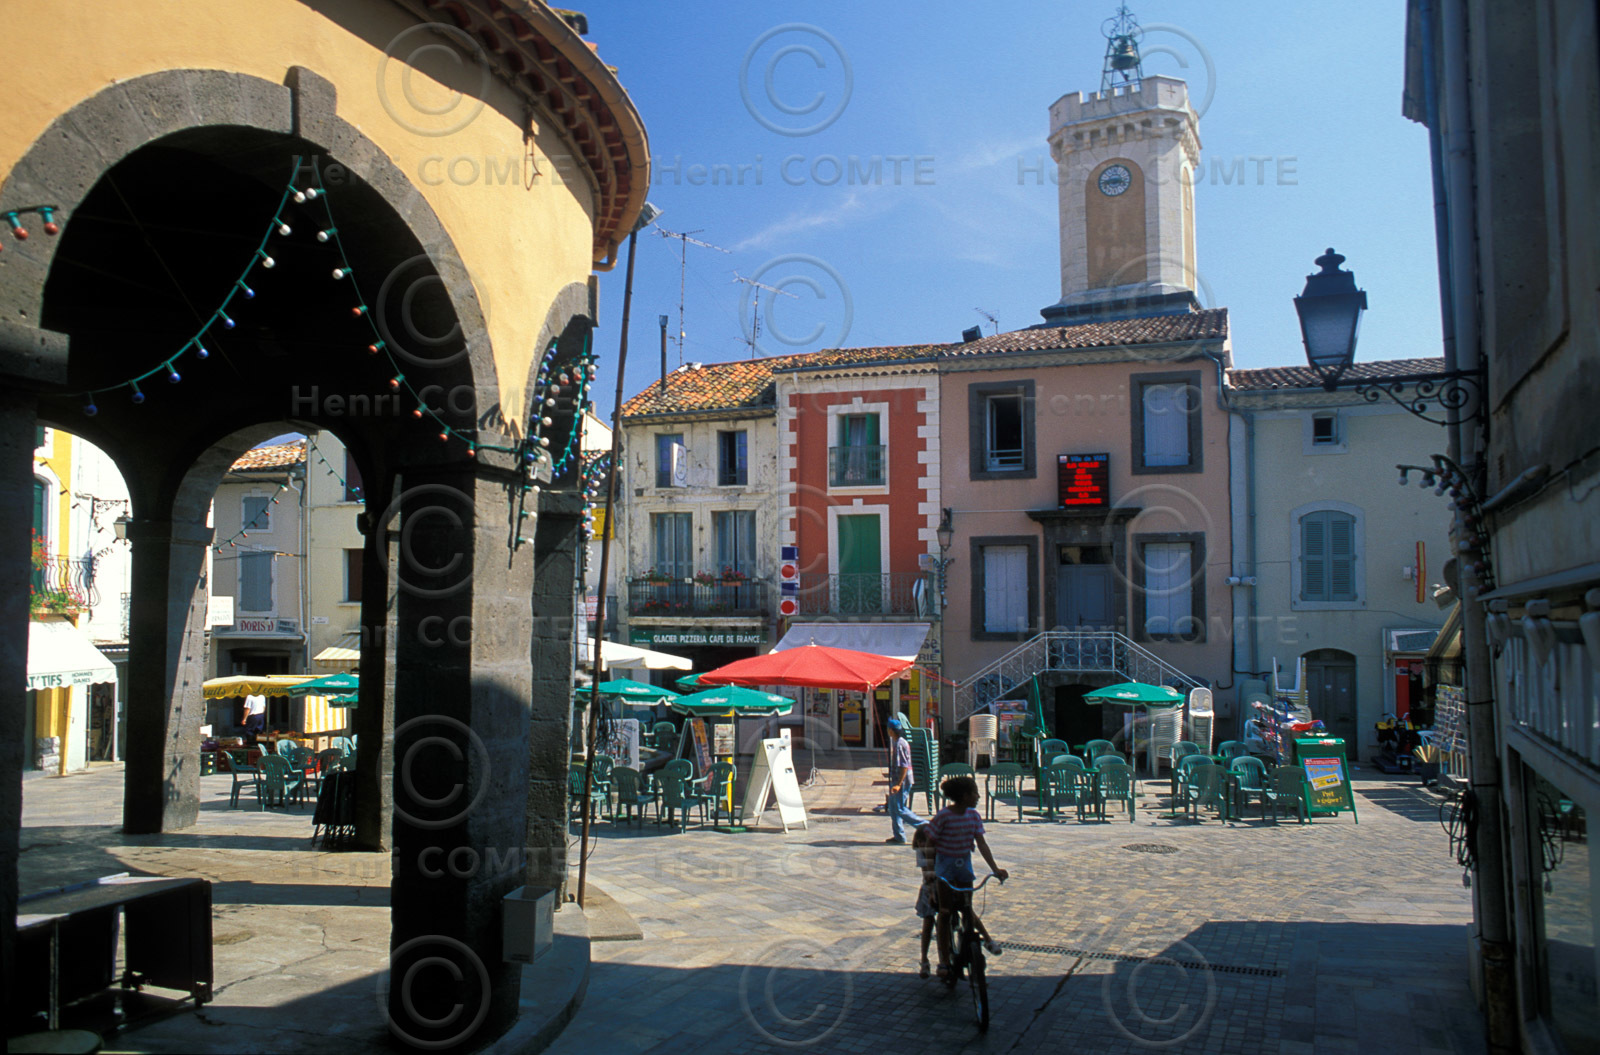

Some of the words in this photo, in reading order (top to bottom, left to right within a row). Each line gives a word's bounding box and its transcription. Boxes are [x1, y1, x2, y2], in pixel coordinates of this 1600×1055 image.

[241, 620, 266, 632] DORIS
[653, 634, 677, 644] GLACIER
[679, 634, 707, 644] PIZZERIA
[709, 634, 724, 644] CAFE
[726, 634, 734, 644] DE
[736, 634, 760, 644] FRANCE
[917, 653, 937, 662] RIE
[234, 685, 243, 694] et
